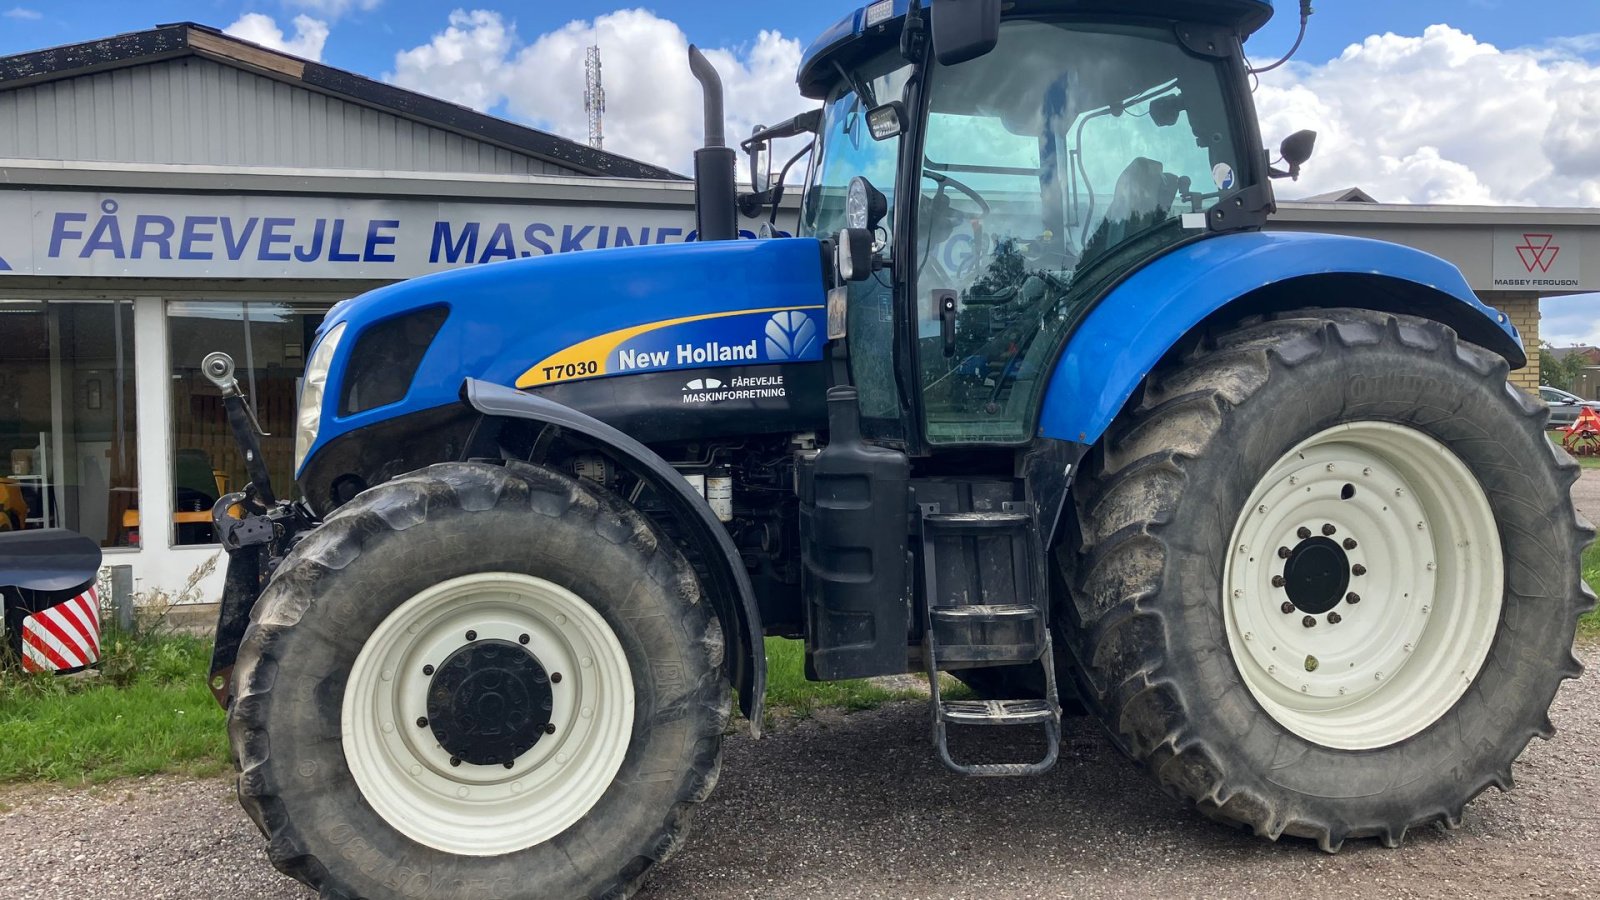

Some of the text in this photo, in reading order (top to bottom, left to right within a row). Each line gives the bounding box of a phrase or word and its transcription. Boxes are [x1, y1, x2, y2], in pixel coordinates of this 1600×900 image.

[48, 198, 400, 263] FÅREVEJLE
[618, 340, 757, 371] New Holland
[542, 360, 598, 381] T7030
[731, 375, 784, 388] FÅREVEJLE
[683, 387, 786, 403] MASKINFORRETNING
